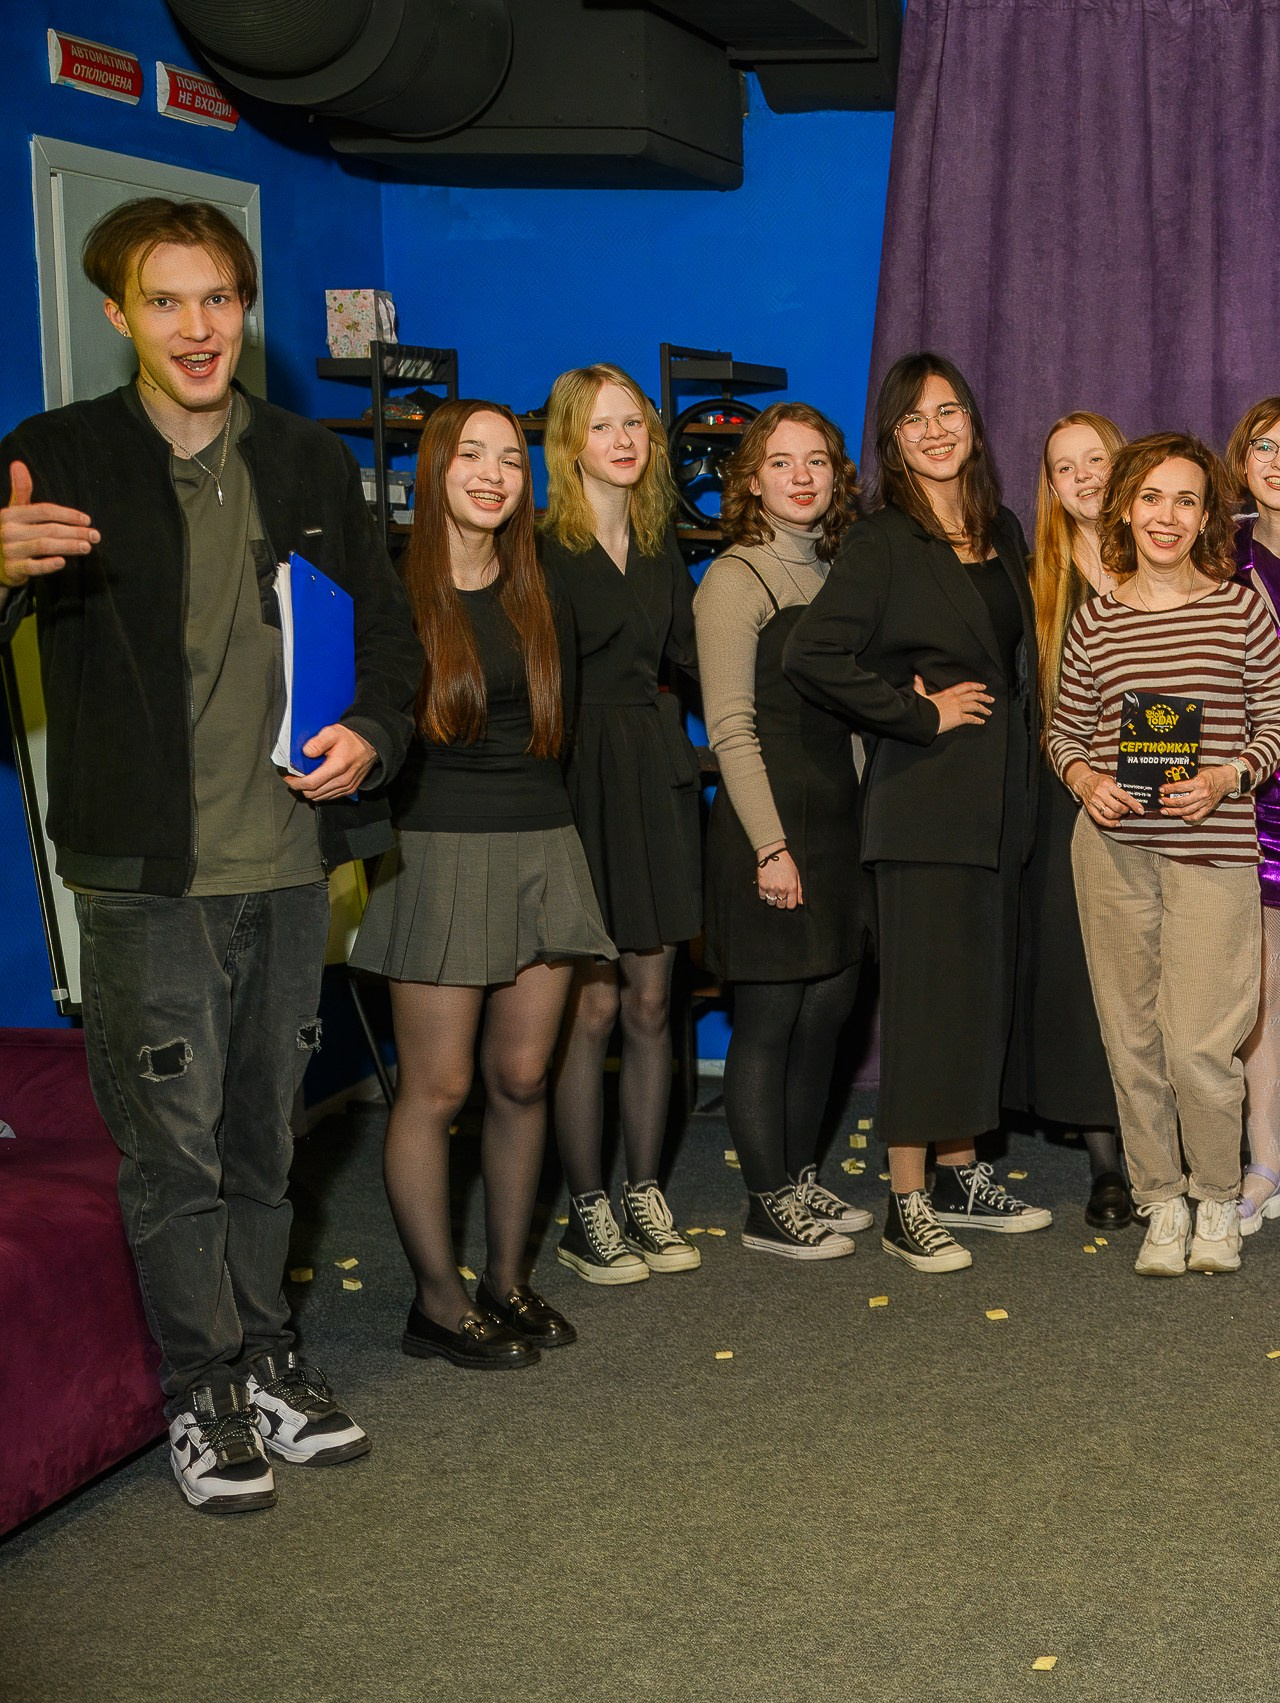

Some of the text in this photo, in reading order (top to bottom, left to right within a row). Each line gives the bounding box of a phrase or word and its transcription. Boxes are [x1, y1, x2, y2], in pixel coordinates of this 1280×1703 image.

[71, 45, 134, 73] АВТОМАТИКА
[73, 63, 132, 91] ОТКЛЮЧЕНА
[176, 75, 225, 100] ПОРОШО
[178, 90, 232, 118] НЕ ВХОДИ!
[1120, 741, 1199, 754] СЕРТИФИКАТ
[1127, 756, 1190, 765] НА 1000 РУБЛЕЙ
